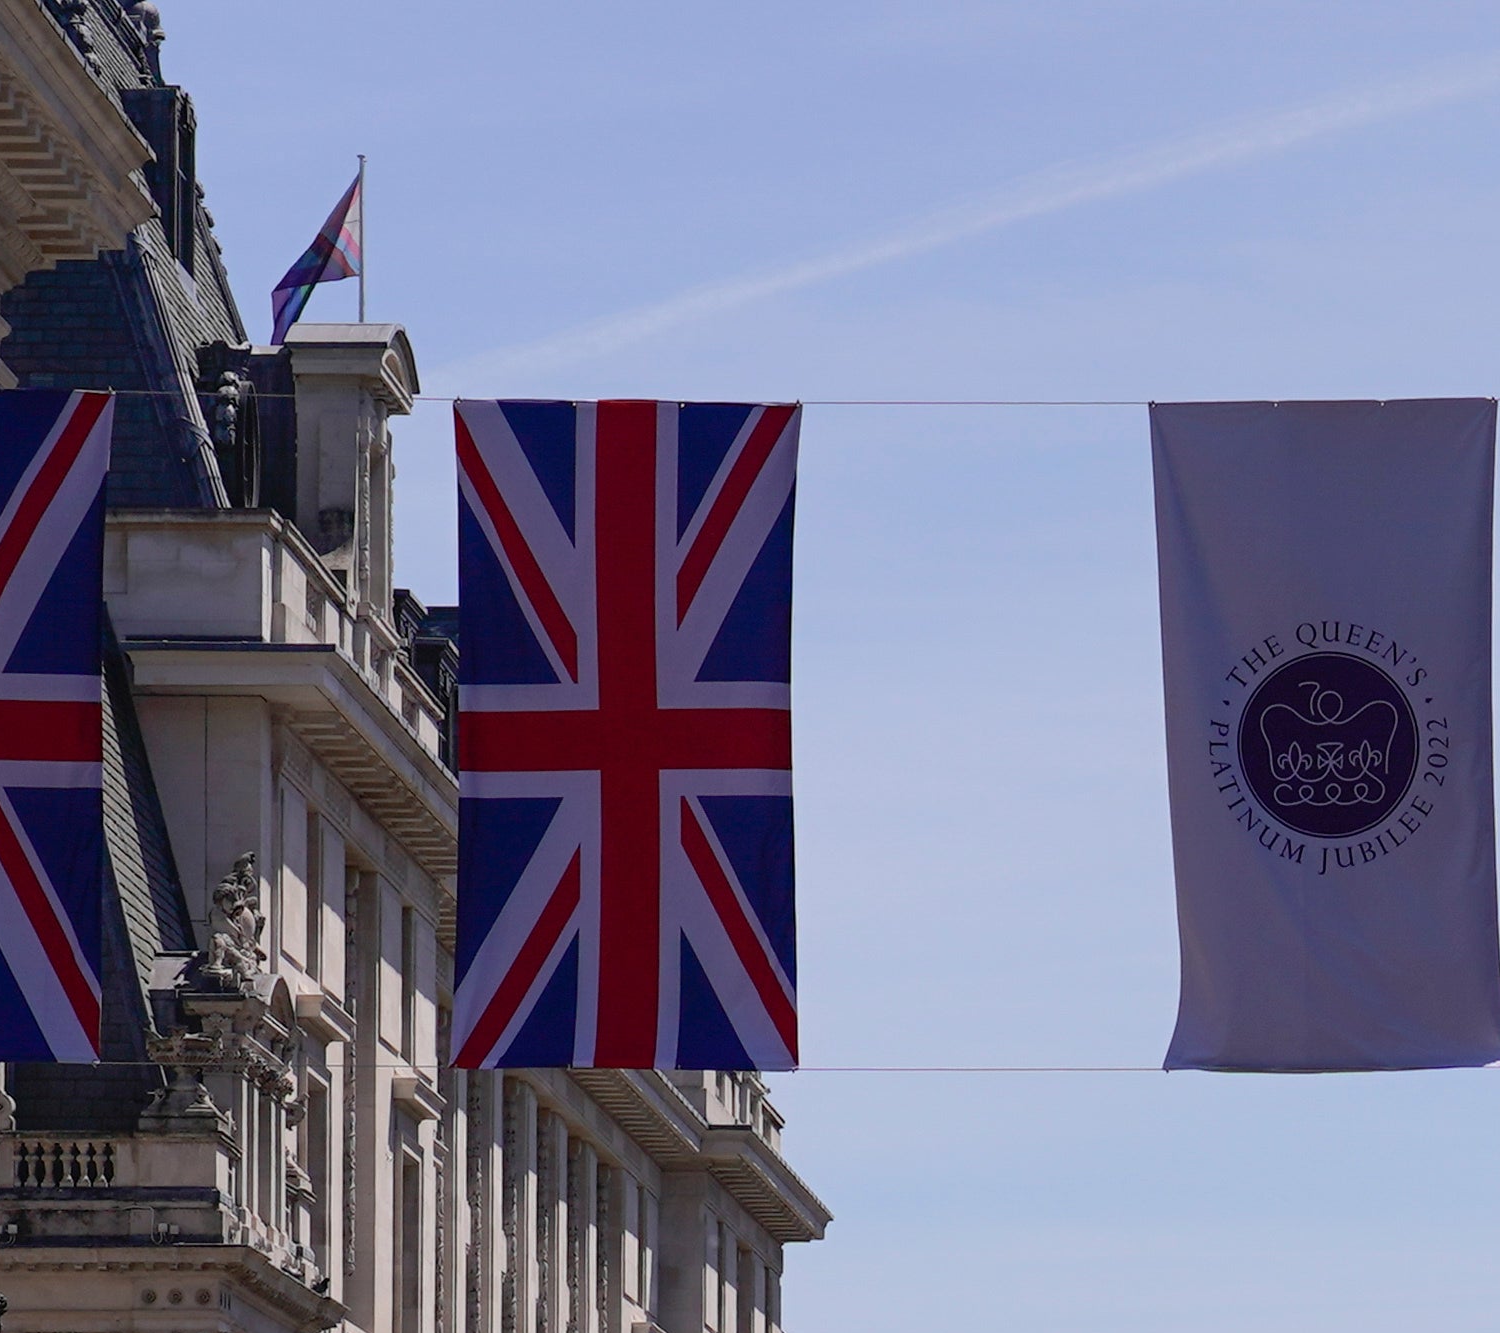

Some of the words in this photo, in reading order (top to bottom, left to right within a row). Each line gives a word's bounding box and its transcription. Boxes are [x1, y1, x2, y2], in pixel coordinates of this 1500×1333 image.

[1225, 635, 1284, 689] THE
[1295, 620, 1428, 688] QUEEN'S
[1208, 719, 1306, 866] PLATINUM
[1318, 797, 1434, 876] JUBILEE
[1424, 718, 1449, 787] 2022
